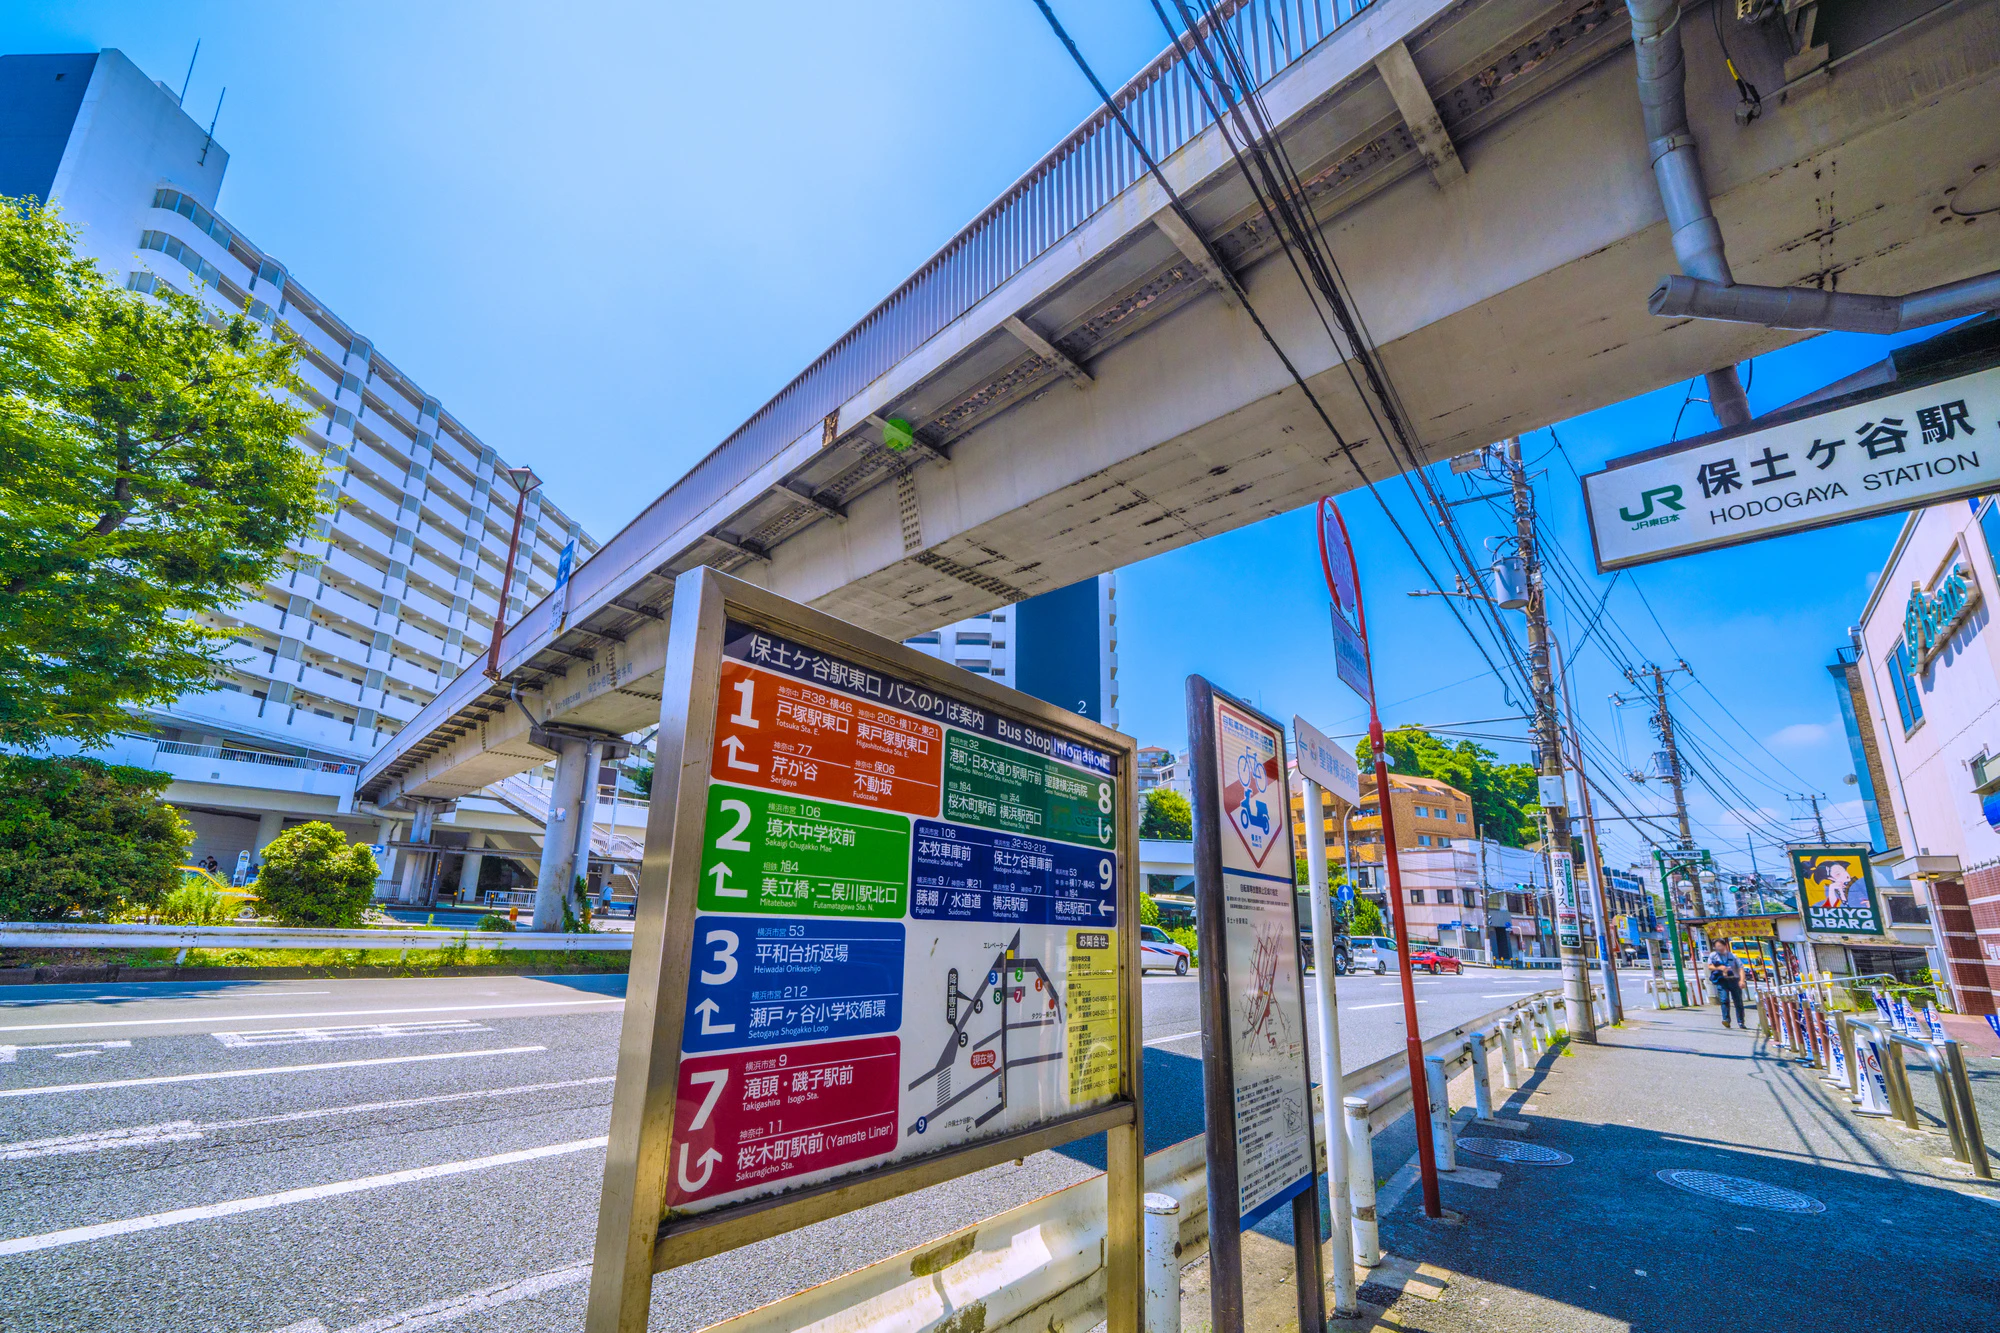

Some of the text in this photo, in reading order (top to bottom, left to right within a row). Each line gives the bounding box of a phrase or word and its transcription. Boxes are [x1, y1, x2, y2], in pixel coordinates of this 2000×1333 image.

[1710, 451, 1980, 525] HODOGAYA STATION
[1619, 484, 1687, 522] JR
[1631, 514, 1681, 531] JR東日本
[730, 679, 759, 729] 1
[778, 685, 852, 713] 神奈中 戸38・横46
[1078, 700, 1087, 714] 2
[776, 700, 849, 734] 戸塚駅東口
[858, 709, 939, 738] 神奈中 205・横17・東21
[887, 681, 985, 731] バスのりば案内
[998, 718, 1022, 742] Bus
[1024, 728, 1051, 752] Stop
[776, 719, 820, 736] Totsuka Sta. E.
[857, 723, 929, 755] 東戸塚駅東口
[950, 736, 979, 750] 横浜市営 32
[774, 741, 812, 756] 神奈中 77
[856, 739, 909, 758] Higashitotsuka Sta. E.
[772, 756, 818, 782] 芹が谷
[854, 760, 895, 775] 神奈中 保06
[950, 748, 1042, 786] 港町・日本大通り駅県庁前
[770, 775, 797, 787] Serigaya
[854, 774, 893, 796] 不動坂
[959, 781, 971, 792] 旭4
[1044, 775, 1088, 798] 聖隷横浜病院
[853, 791, 878, 802] Fudozaka
[1010, 793, 1020, 803] 浜4
[1098, 783, 1111, 814] 8
[768, 803, 821, 818] 横浜市営 106
[948, 793, 996, 817] 桜木町駅前
[948, 809, 972, 819] Sakuragicho
[1000, 804, 1042, 826] 横浜駅西口
[715, 799, 752, 852] 2
[766, 818, 856, 847] 境木中学校前
[919, 827, 956, 839] 横浜市営 106
[765, 838, 832, 853] Sakaigi Chugakko Mae
[918, 840, 972, 862] 本牧車庫前
[994, 839, 1010, 848] 横浜市営
[763, 860, 799, 873] 相鉄 旭4
[917, 856, 939, 866] Honmoku
[994, 850, 1053, 872] 保土ケ谷車庫前
[993, 866, 1012, 875] Hodogaya
[1099, 858, 1113, 891] 9
[916, 876, 937, 885] 横浜市営
[938, 875, 944, 885] 9
[966, 878, 982, 889] 東21
[1010, 883, 1015, 892] 9
[1034, 885, 1042, 893] 77
[1069, 879, 1095, 889] 横17・横46
[1554, 859, 1567, 906] 銀座ハリス
[761, 877, 897, 904] 美立橋・二俣川駅北口
[760, 898, 874, 912] Mitatebashi Futamatagawa Sta. N.
[916, 890, 981, 908] 藤棚 水道道
[993, 897, 1028, 912] 横浜駅前
[915, 907, 971, 916] Fujidana Suidomichi
[1055, 900, 1091, 915] 横浜駅西口
[1809, 908, 1872, 919] UKIYO
[1825, 918, 1861, 929] BAR
[757, 926, 805, 937] 横浜市営 53
[700, 930, 740, 985] 3
[755, 944, 848, 963] 平和台折返場
[754, 965, 821, 974] Heiwadai Orikaeshijo
[1017, 970, 1021, 980] 2
[990, 972, 996, 983] 3
[751, 986, 808, 1000] 横浜市営 212
[948, 973, 957, 1019] 降車専用
[995, 992, 1000, 1002] 8
[1016, 991, 1020, 1001] 7
[976, 1001, 981, 1012] 4
[748, 1025, 829, 1039] Setogaya Shogakko Loop
[961, 1035, 966, 1045] 5
[745, 1054, 787, 1072] 横浜市営 9
[972, 1053, 994, 1066] 現在地
[743, 1065, 853, 1100] 滝頭・磯子駅前
[688, 1069, 729, 1132] 7
[742, 1092, 819, 1112] Takigashira Isogo Sta.
[739, 1120, 783, 1140] 神奈中 11
[918, 1119, 925, 1131] 9
[737, 1123, 894, 1171] 桜木町駅前 (Yamate Liner)
[736, 1162, 794, 1182] Sakuragicho Sta.
